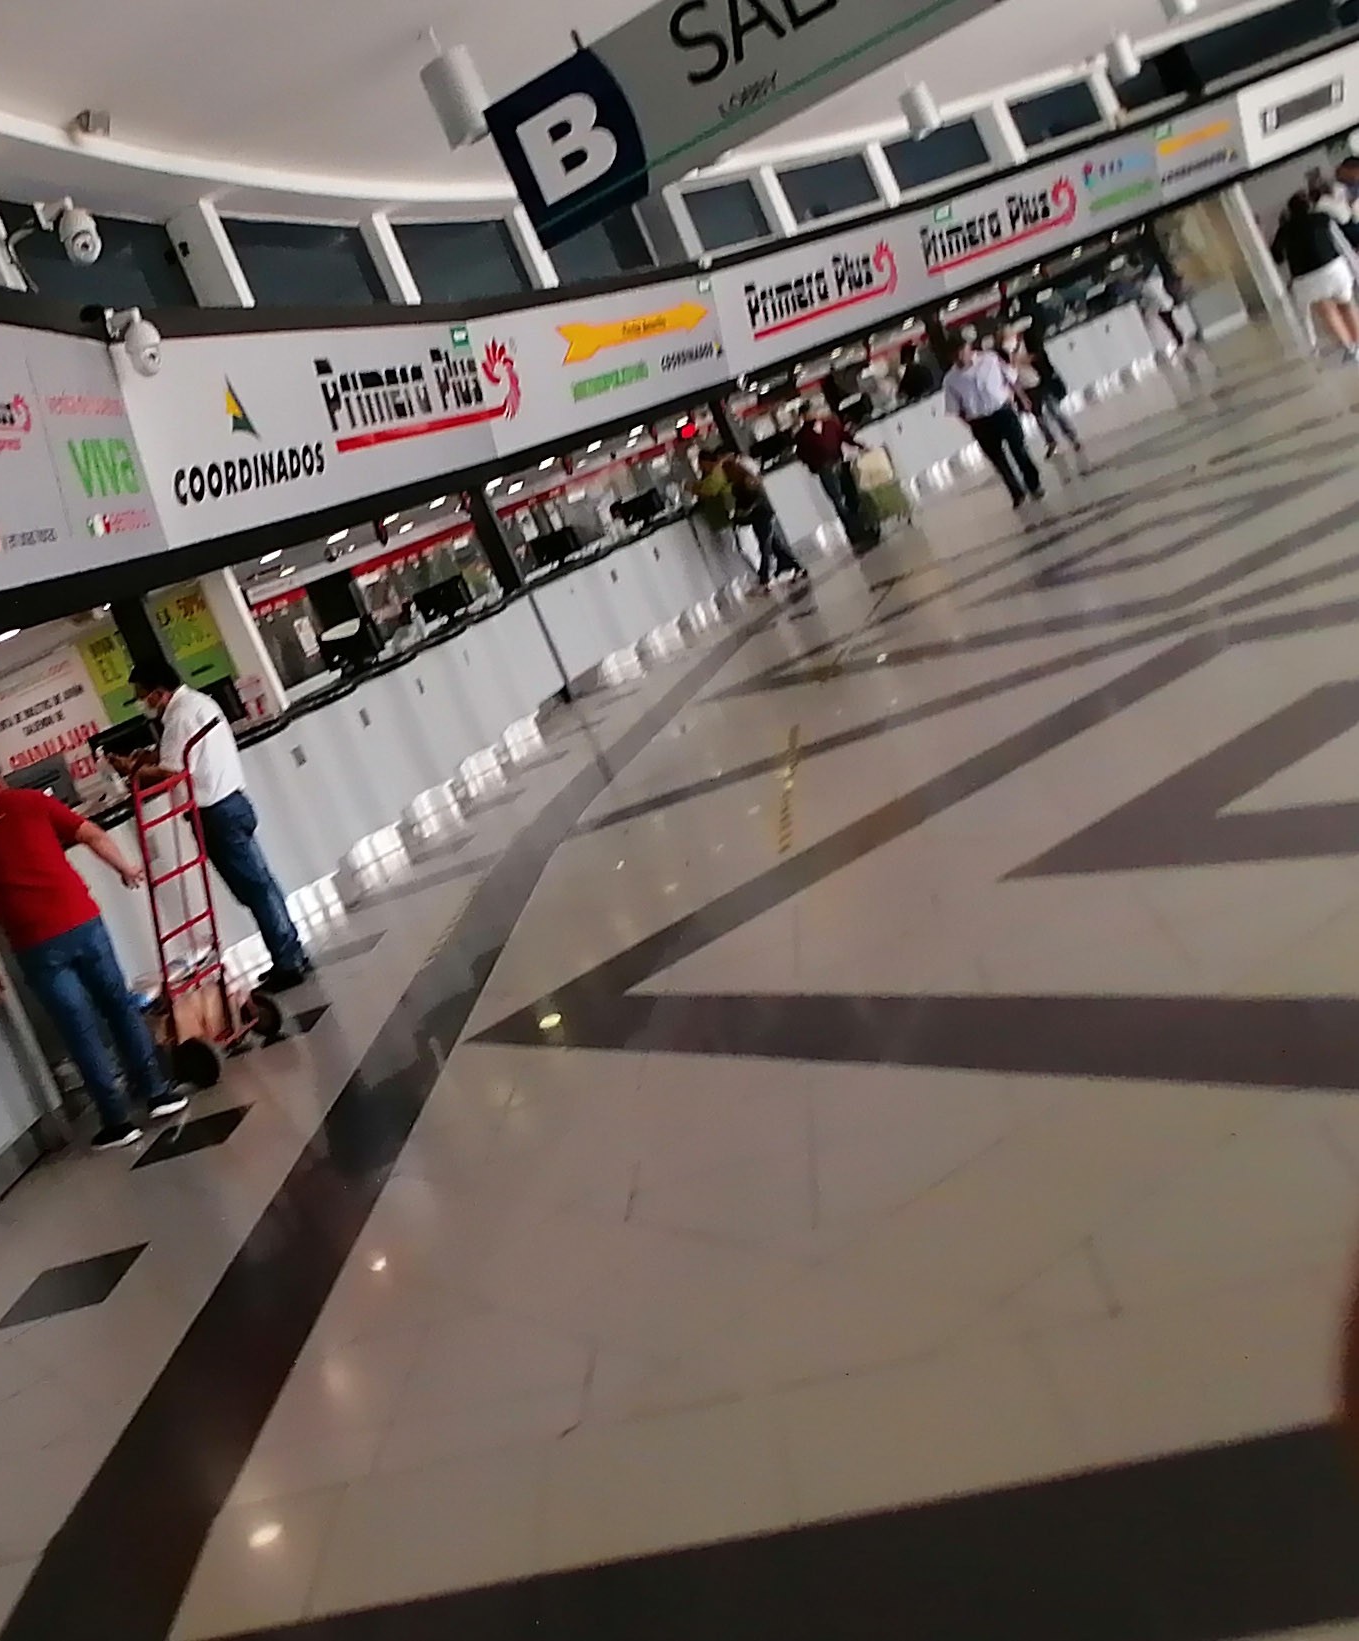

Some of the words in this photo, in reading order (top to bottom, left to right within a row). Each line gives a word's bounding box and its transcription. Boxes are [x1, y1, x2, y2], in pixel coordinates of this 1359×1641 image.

[516, 92, 618, 207] B
[918, 209, 1001, 268] Primera
[1005, 190, 1051, 232] Plus
[744, 268, 830, 328] Primera
[831, 253, 875, 299] Plus
[314, 358, 433, 431] Primera
[429, 348, 484, 412] Plus
[174, 442, 325, 506] COORDINADOS
